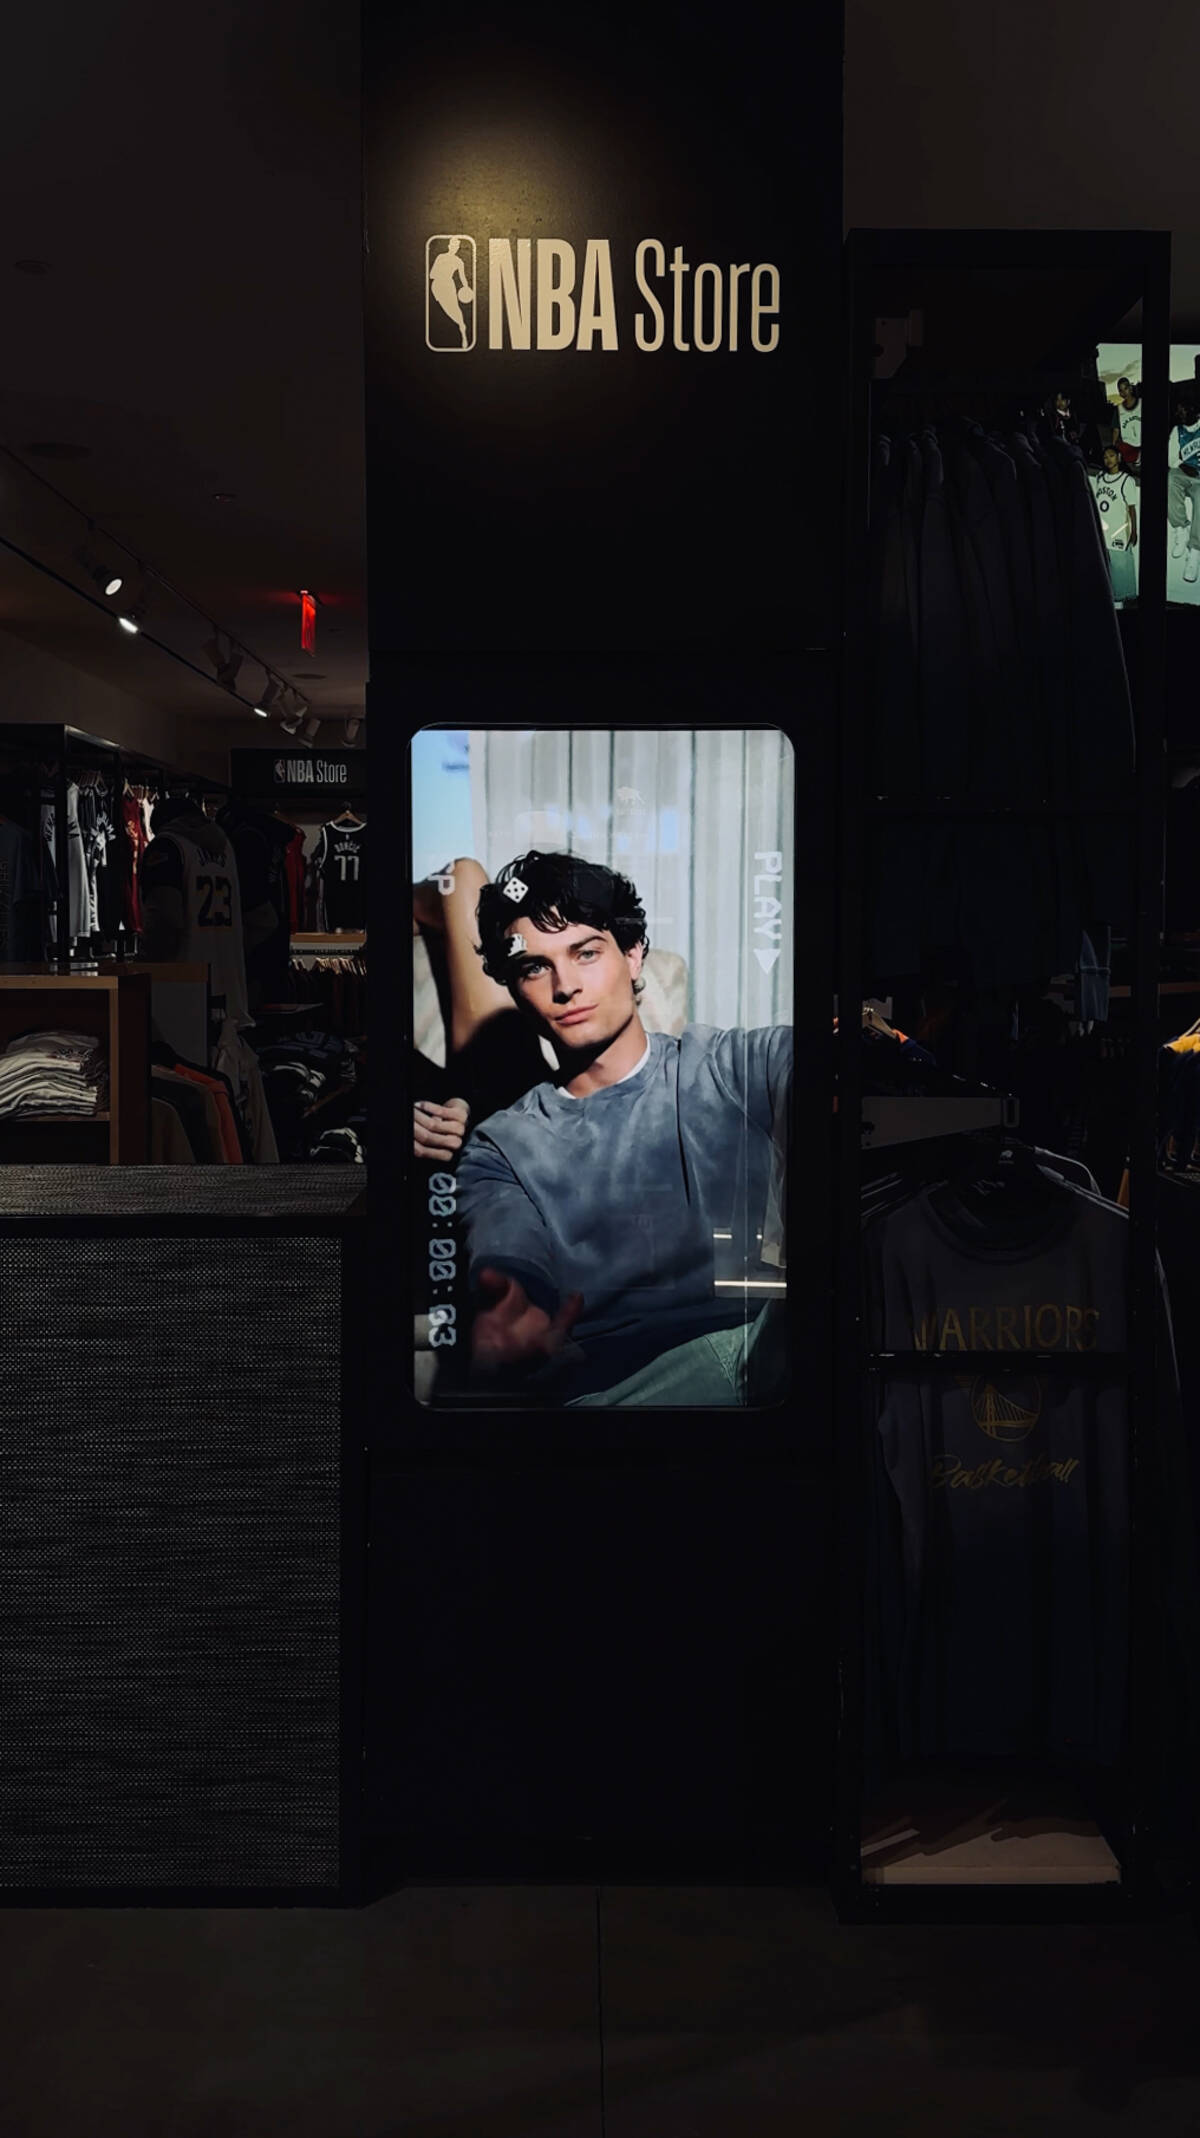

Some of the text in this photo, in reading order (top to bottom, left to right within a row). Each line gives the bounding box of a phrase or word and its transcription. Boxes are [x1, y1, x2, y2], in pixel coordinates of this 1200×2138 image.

[488, 238, 781, 352] NBA Store
[286, 760, 348, 783] NBA Store
[196, 875, 232, 927] 23
[333, 855, 360, 881] 77
[753, 851, 782, 940] PLAY
[428, 1172, 457, 1347] 00:00:03
